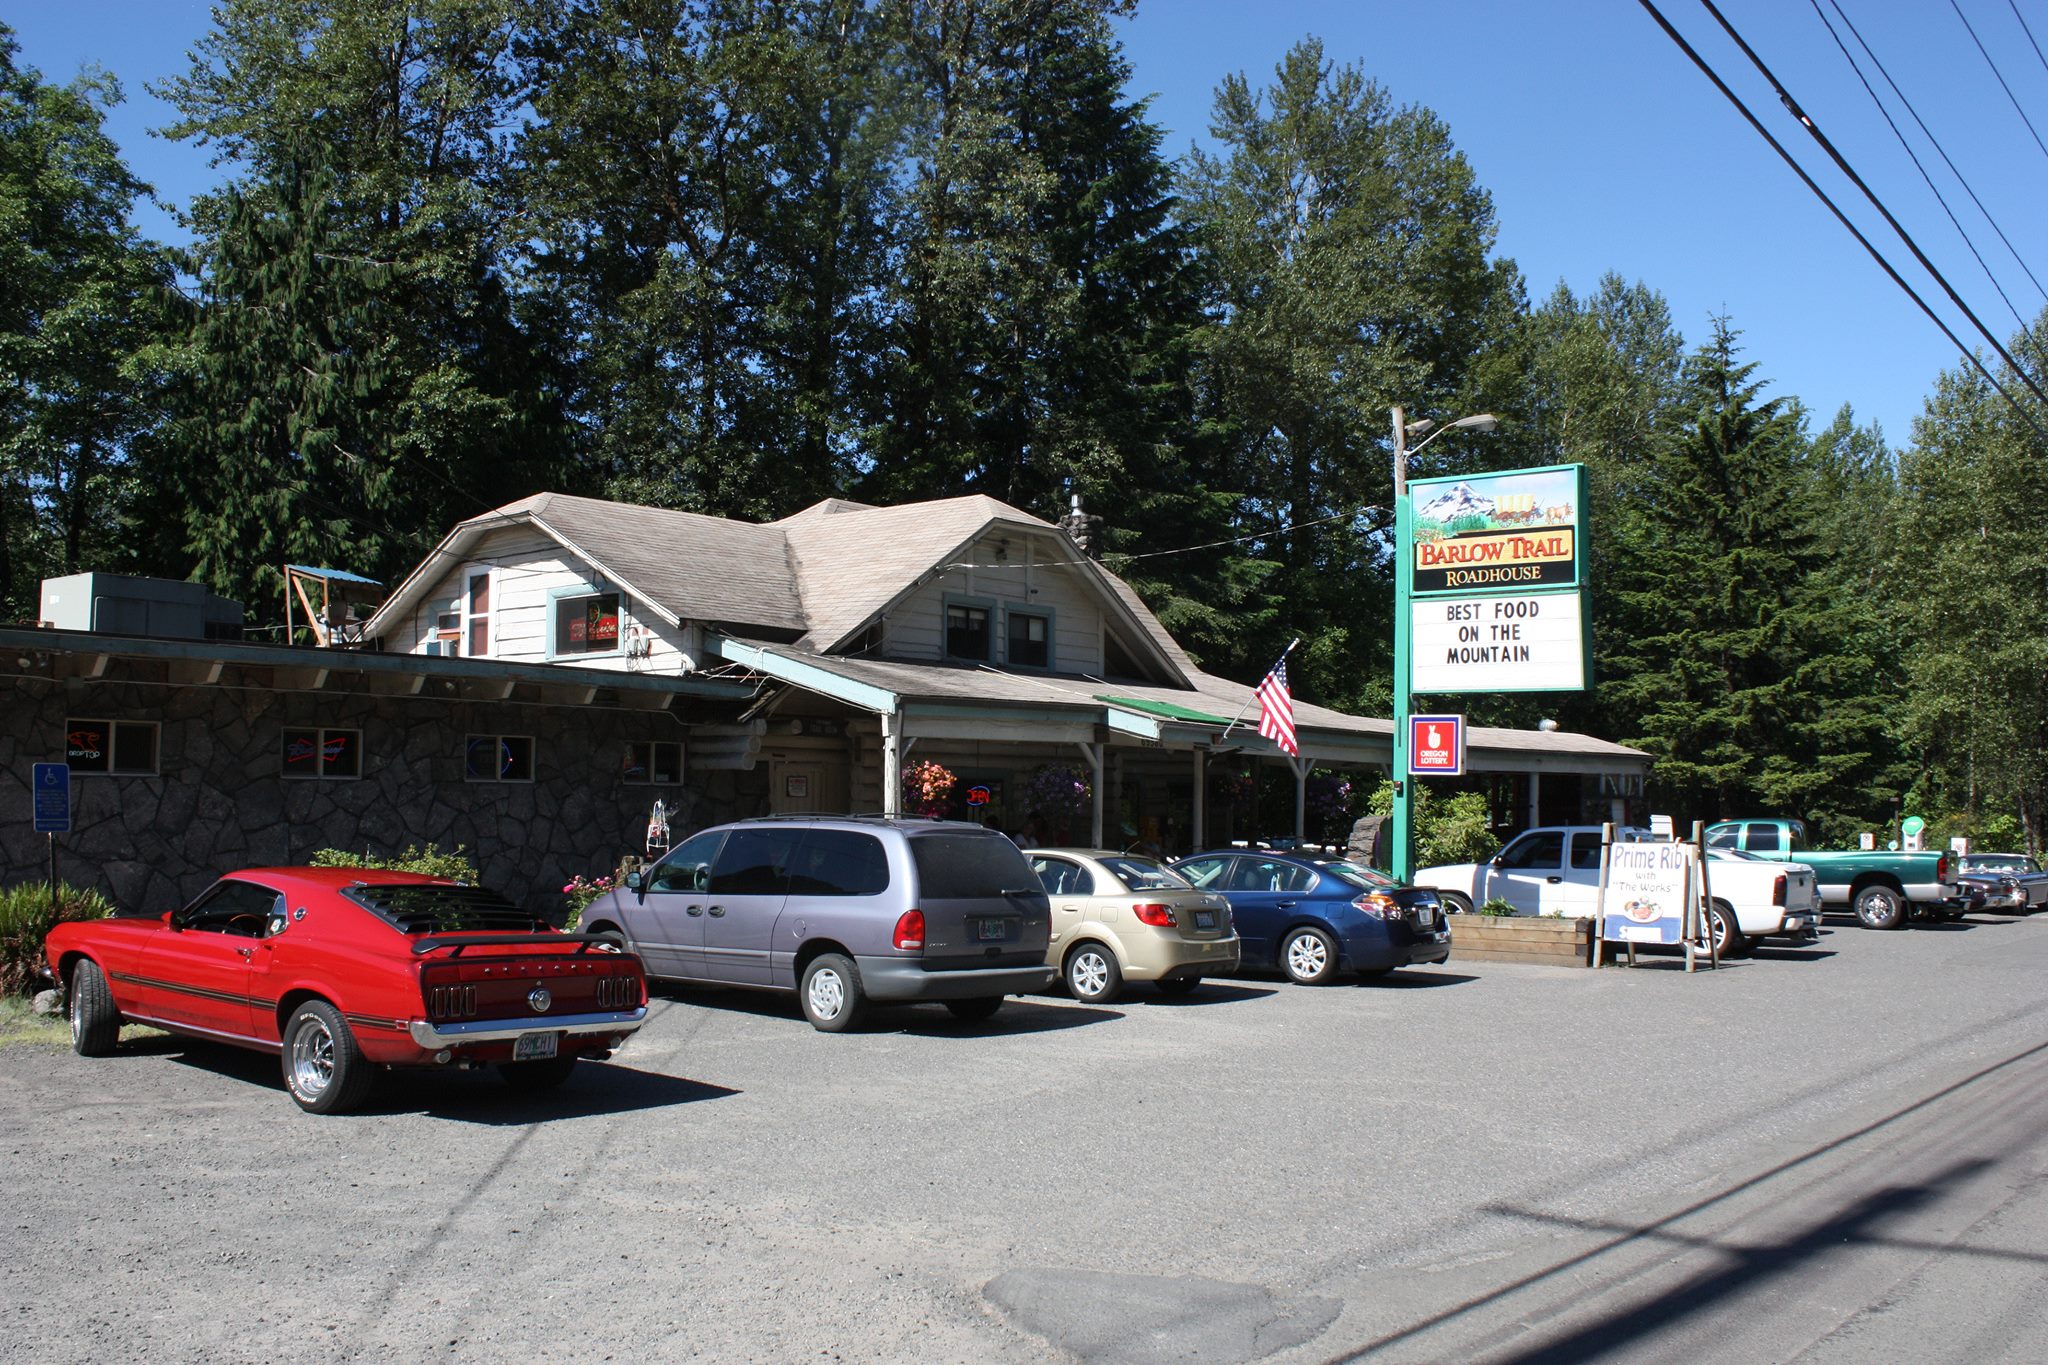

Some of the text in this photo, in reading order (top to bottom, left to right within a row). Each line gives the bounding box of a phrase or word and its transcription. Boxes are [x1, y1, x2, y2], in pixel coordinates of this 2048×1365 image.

[1421, 537, 1569, 565] BARLOW TRAIL
[1446, 566, 1541, 586] ROADHOUSE
[1447, 601, 1539, 621] BEST FOOD
[1458, 624, 1521, 642] ON THE
[1447, 646, 1530, 664] MOUNTAIN
[1420, 750, 1448, 758] OREGON
[1614, 845, 1683, 869] Prime Rib
[1636, 872, 1656, 880] with
